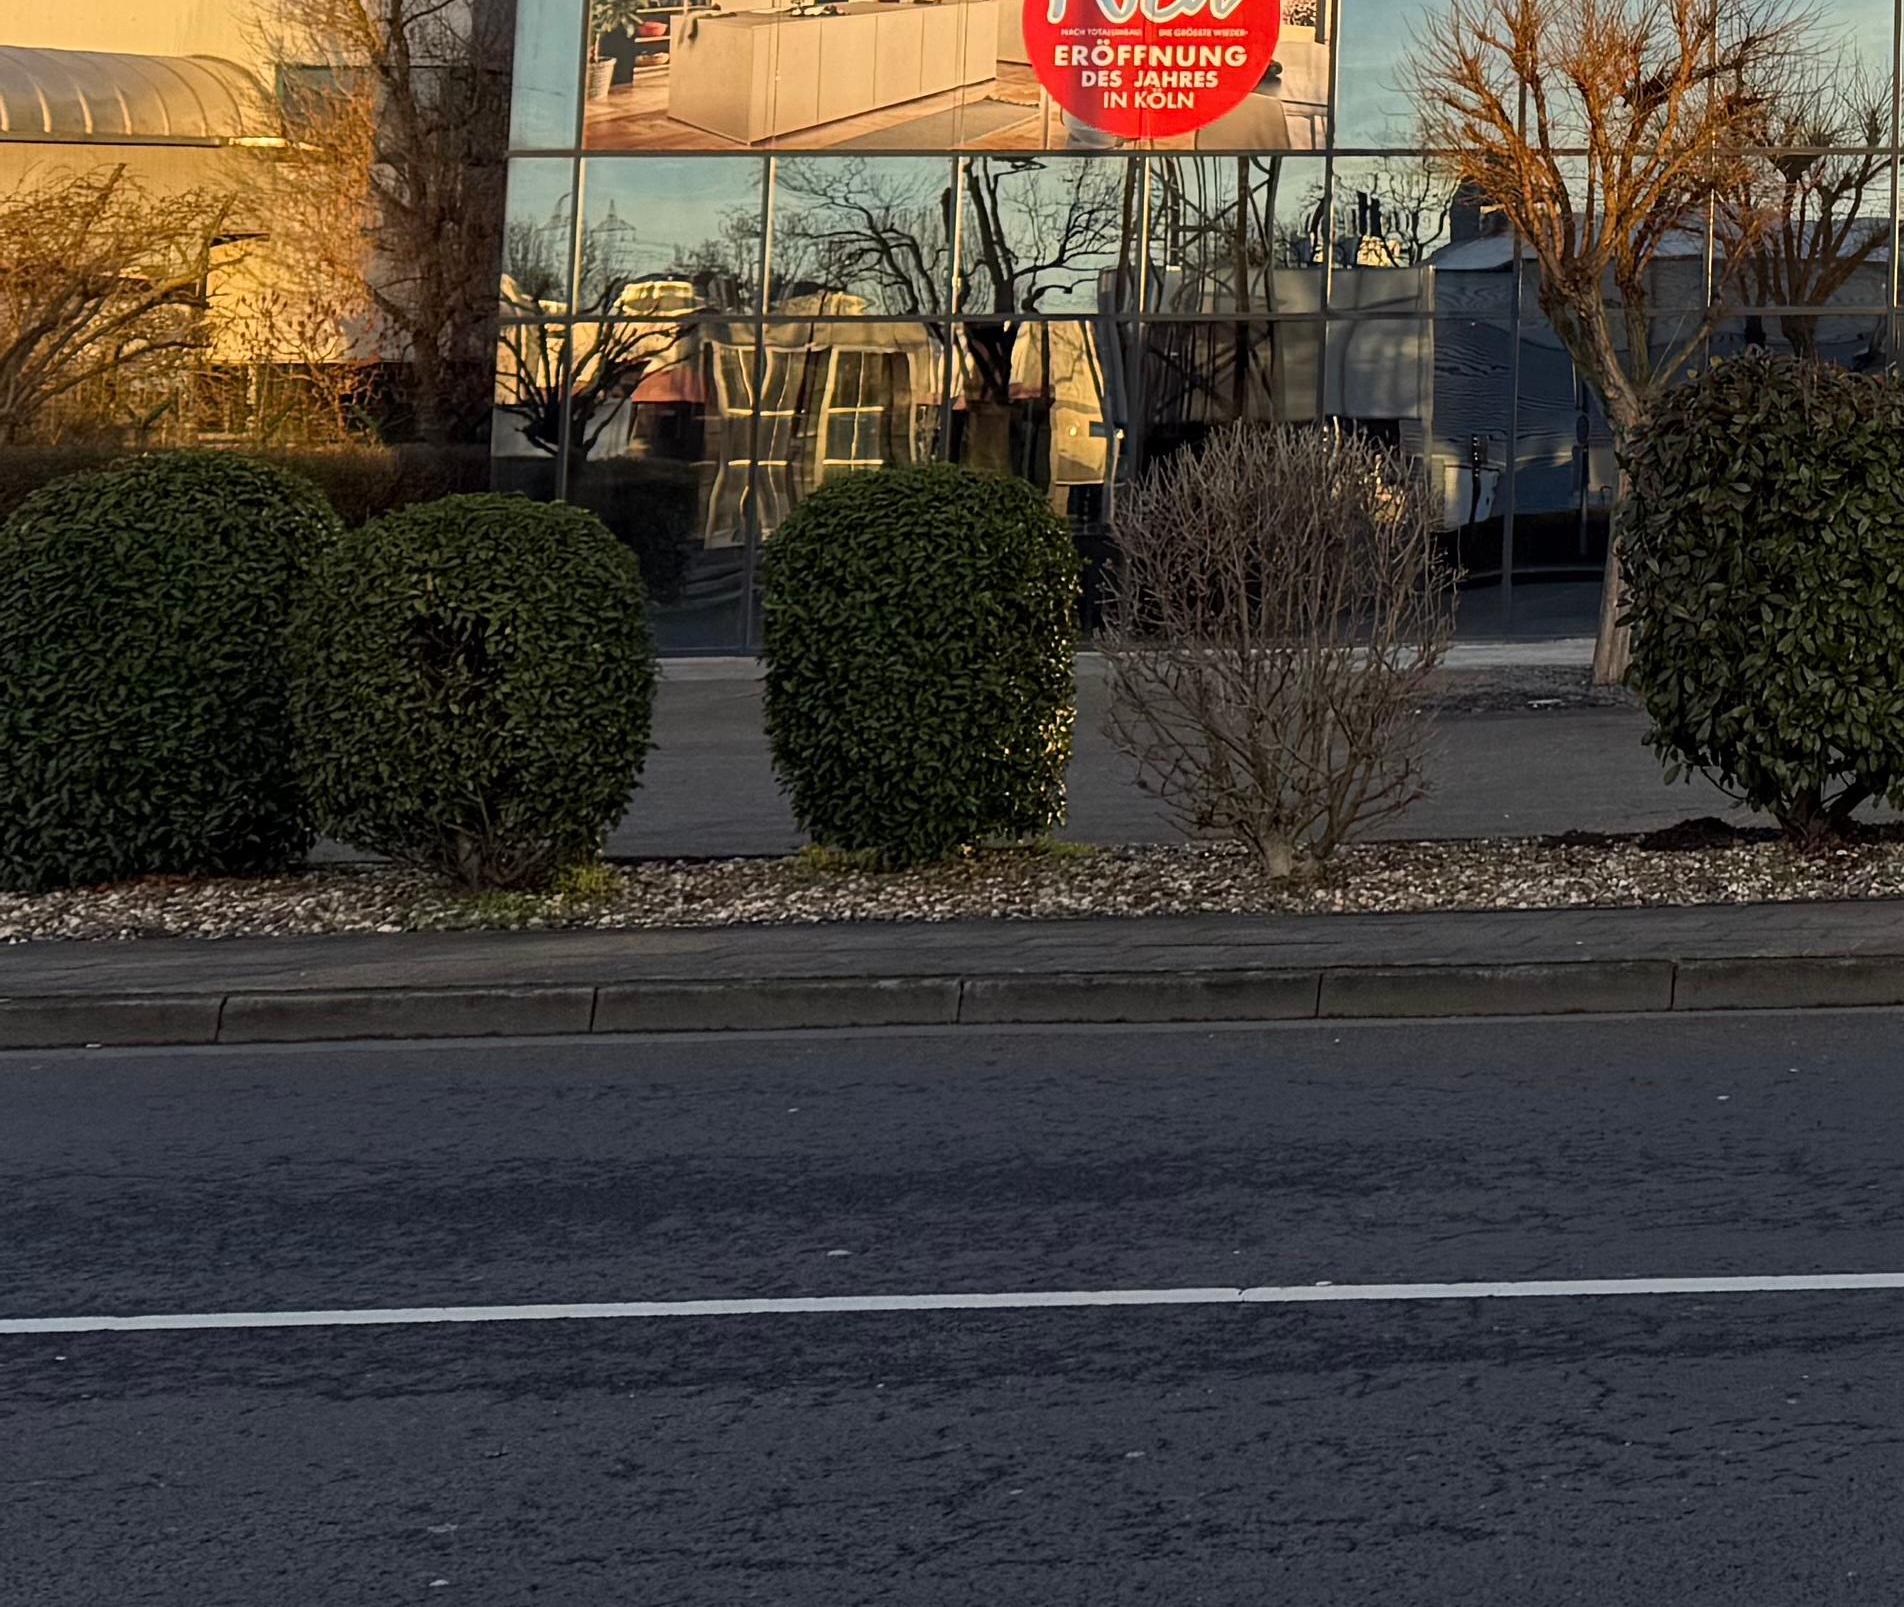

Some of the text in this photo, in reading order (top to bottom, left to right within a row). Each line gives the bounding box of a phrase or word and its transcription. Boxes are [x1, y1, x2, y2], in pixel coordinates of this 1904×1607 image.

[1054, 39, 1248, 67] ERÖFFNUNG
[1081, 70, 1219, 88] DES JAHRES
[1103, 88, 1195, 110] IN KÖLN
